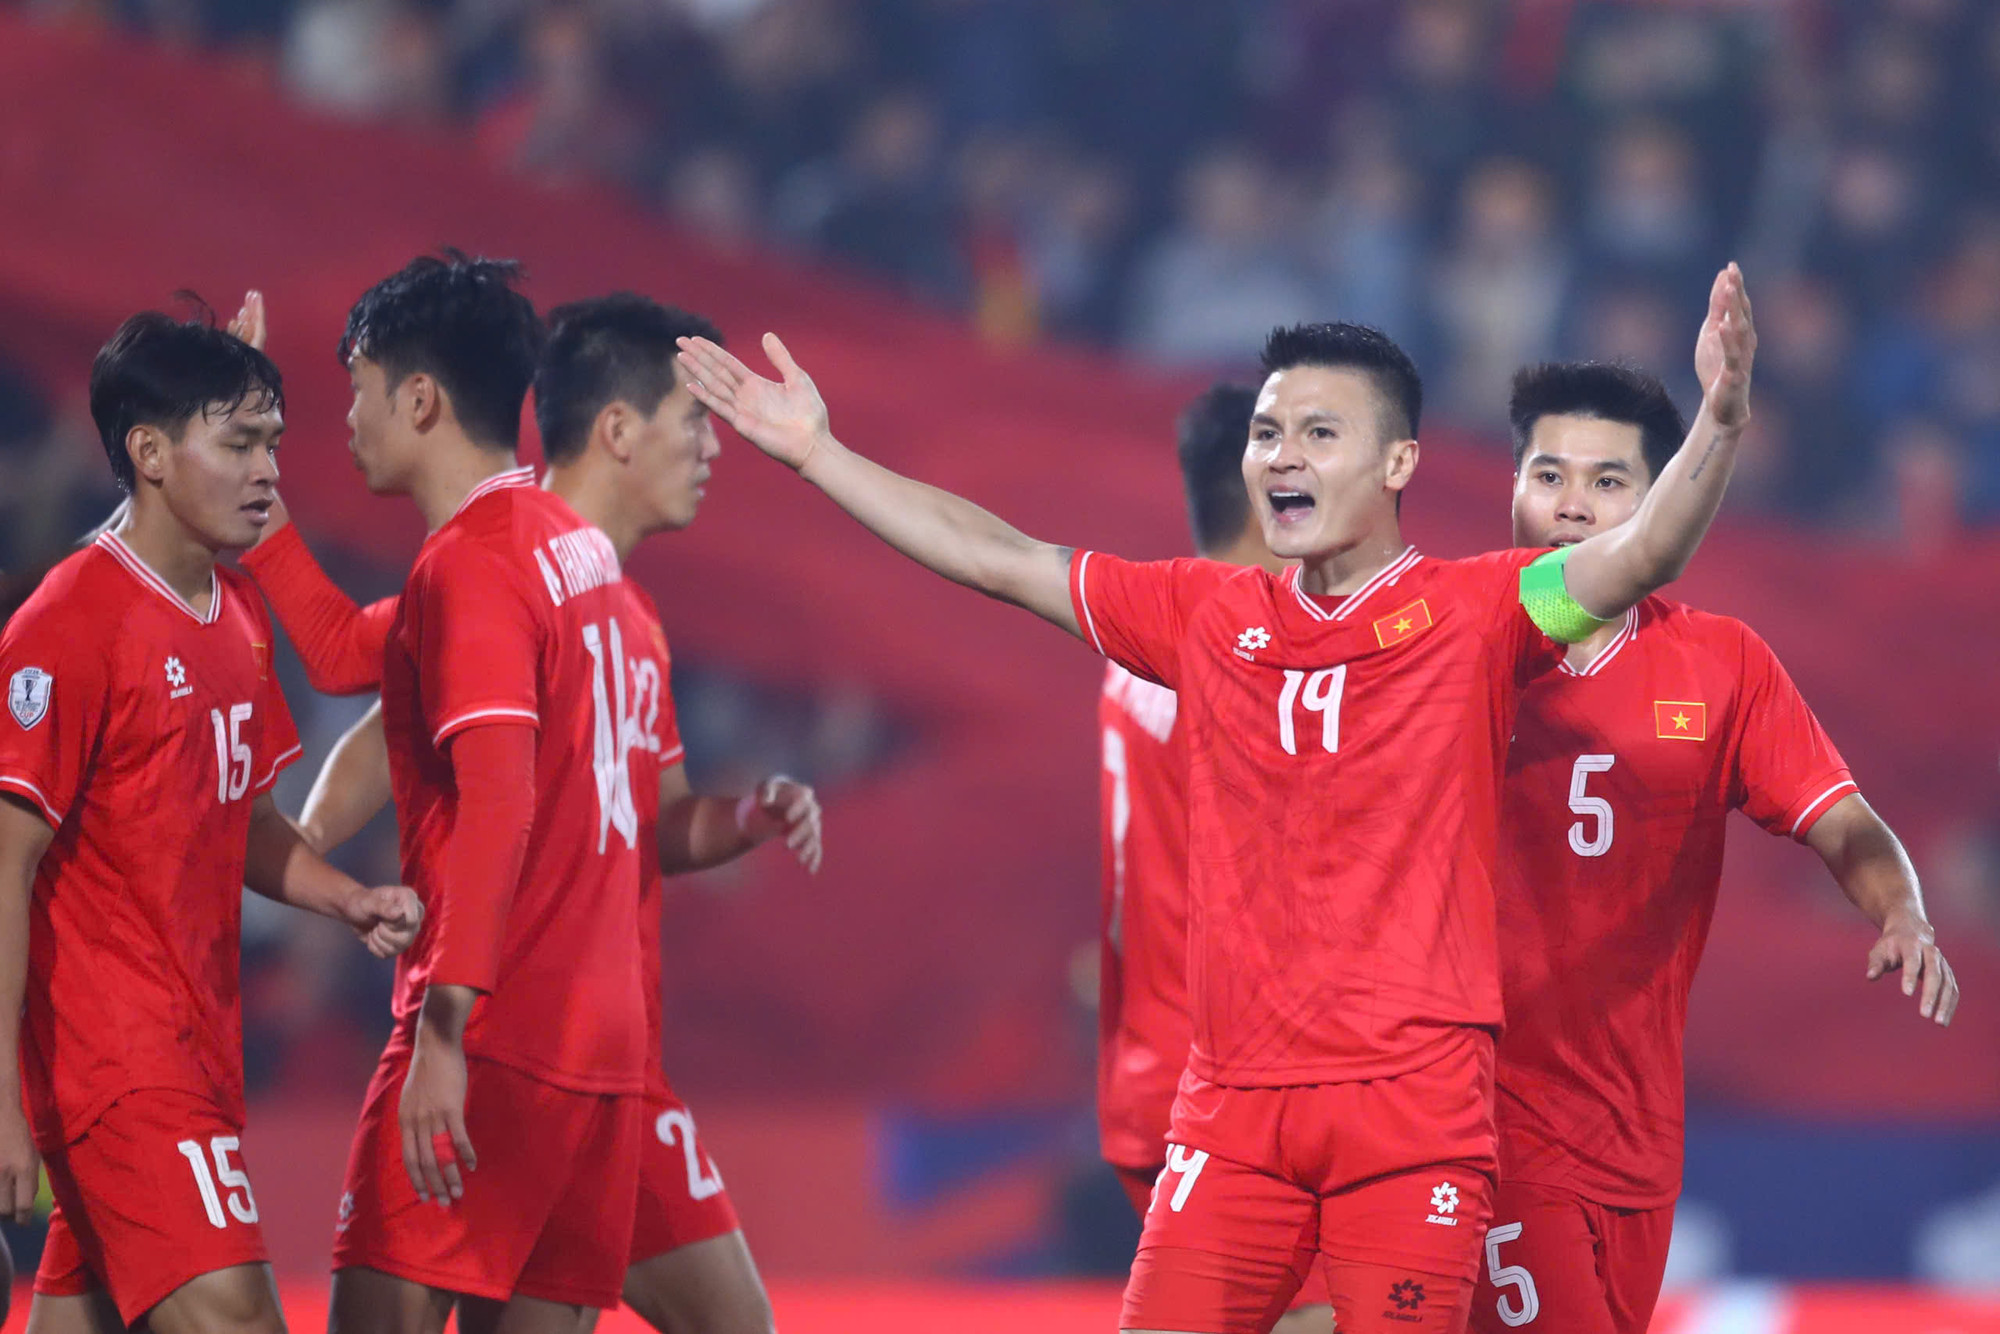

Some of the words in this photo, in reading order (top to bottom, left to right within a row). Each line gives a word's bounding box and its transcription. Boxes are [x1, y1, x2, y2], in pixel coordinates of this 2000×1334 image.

[211, 702, 252, 804] 15
[1278, 664, 1347, 755] 19
[1568, 754, 1615, 857] 5
[177, 1136, 259, 1229] 15
[1485, 1222, 1539, 1327] 5
